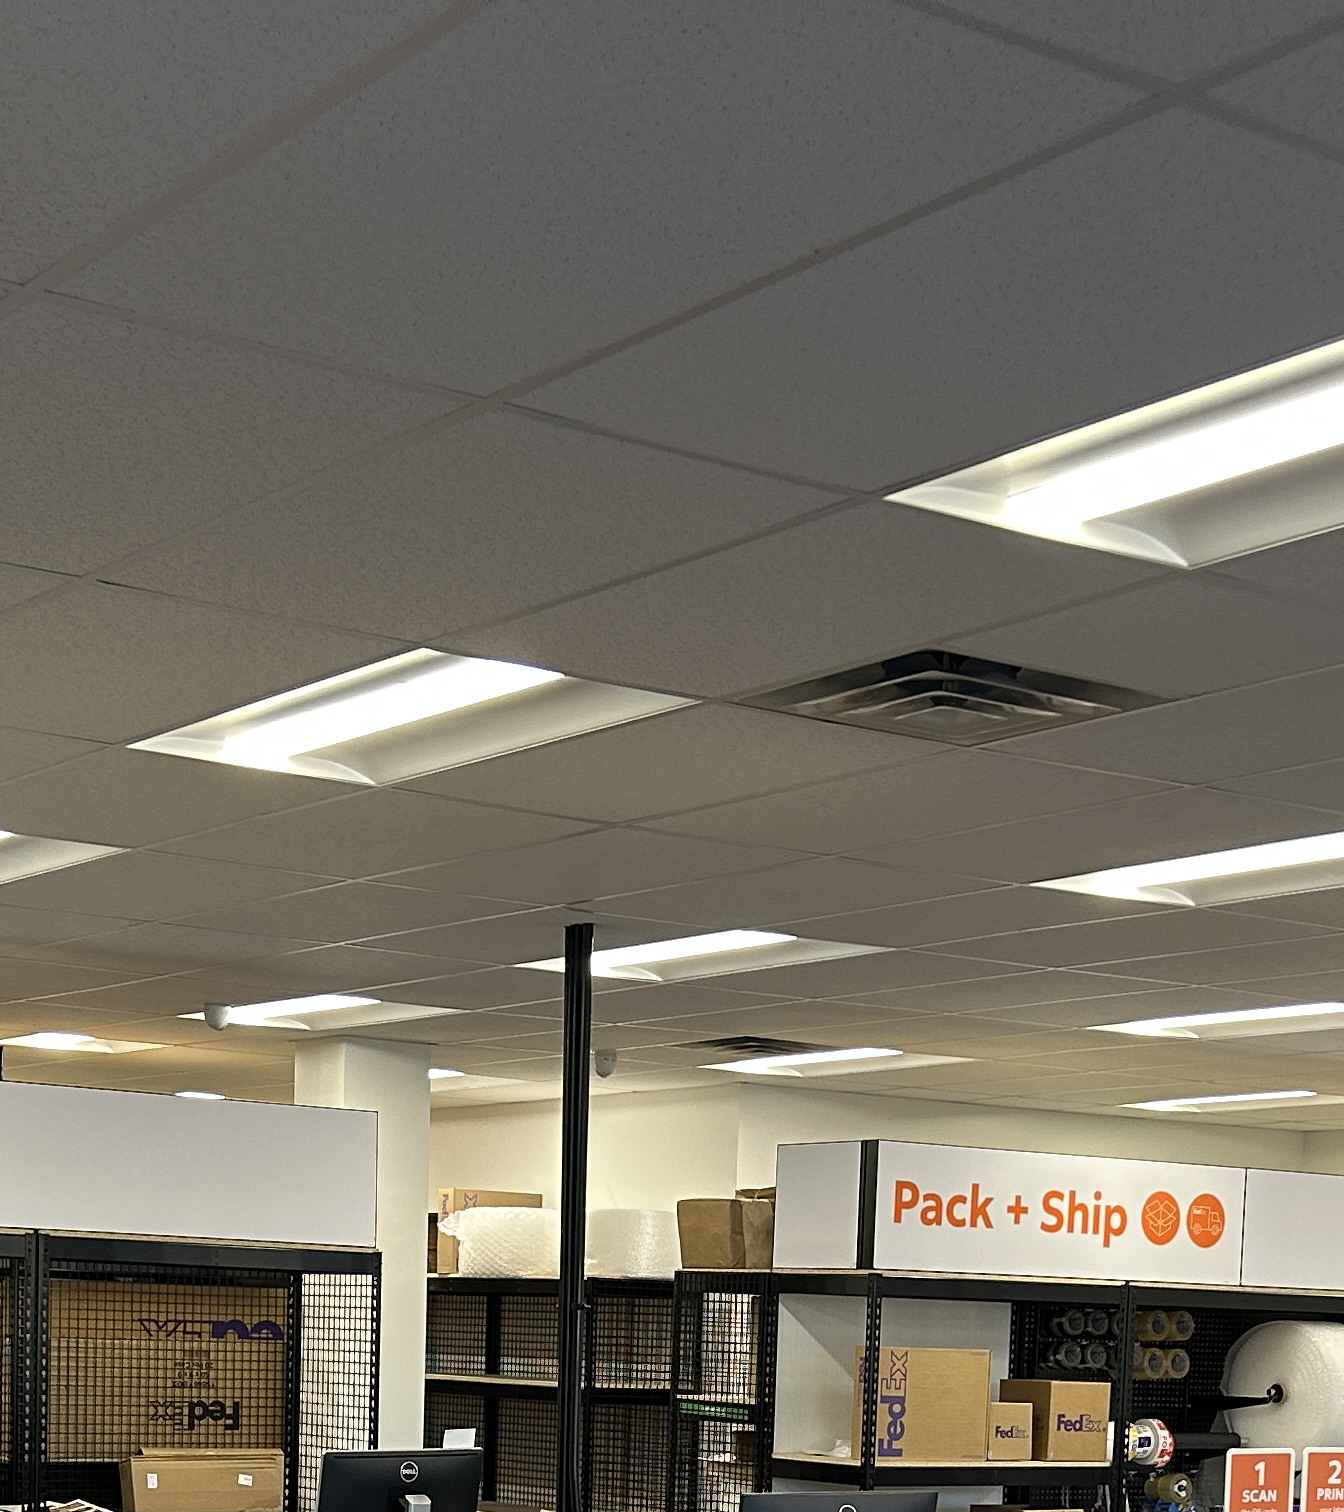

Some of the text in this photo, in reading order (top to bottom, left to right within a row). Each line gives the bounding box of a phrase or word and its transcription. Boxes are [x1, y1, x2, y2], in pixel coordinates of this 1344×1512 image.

[892, 1178, 1128, 1248] Pack + Ship
[877, 1350, 909, 1458] FedEx
[994, 1425, 1029, 1440] FedEx
[1056, 1413, 1107, 1434] FedEx
[1254, 1461, 1265, 1486] 1
[1327, 1460, 1343, 1485] 2
[1241, 1489, 1278, 1503] SCAN
